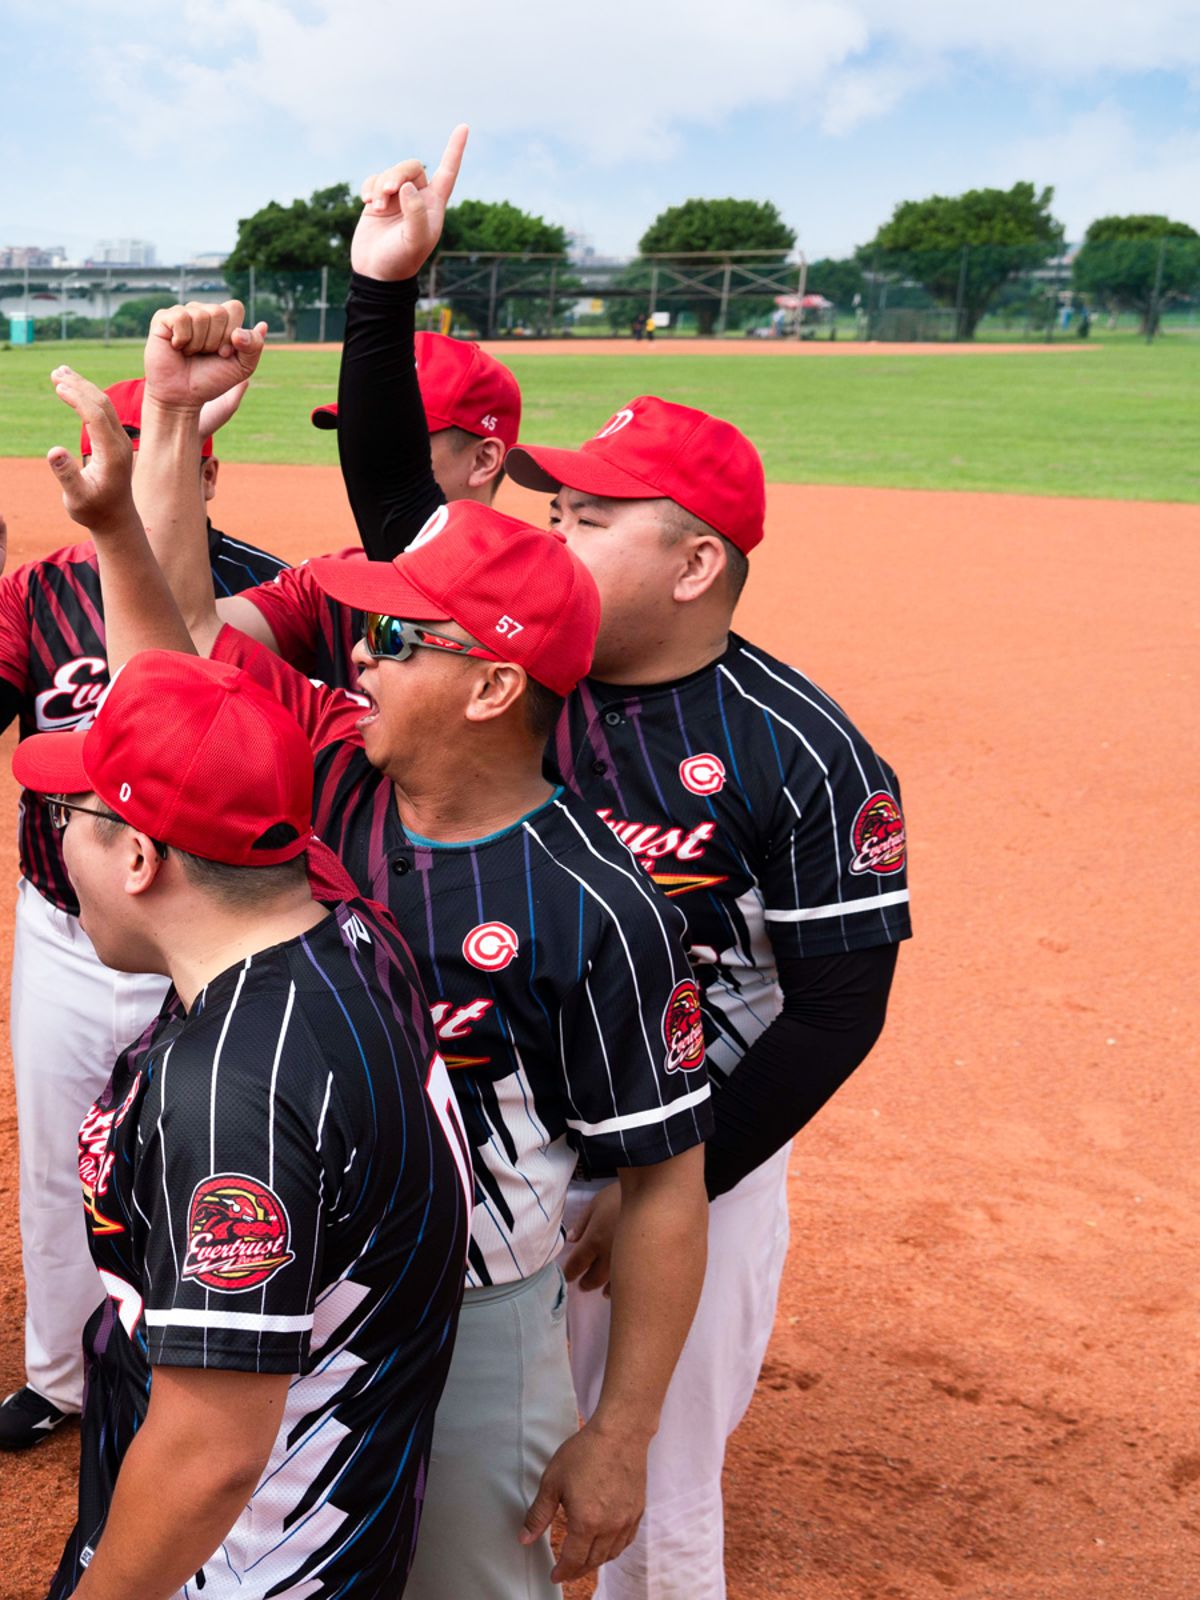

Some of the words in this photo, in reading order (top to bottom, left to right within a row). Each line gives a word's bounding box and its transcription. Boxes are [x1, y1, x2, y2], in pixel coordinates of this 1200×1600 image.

[481, 414, 499, 432] 45
[494, 614, 525, 640] 57
[188, 1232, 286, 1264] Evertrust
